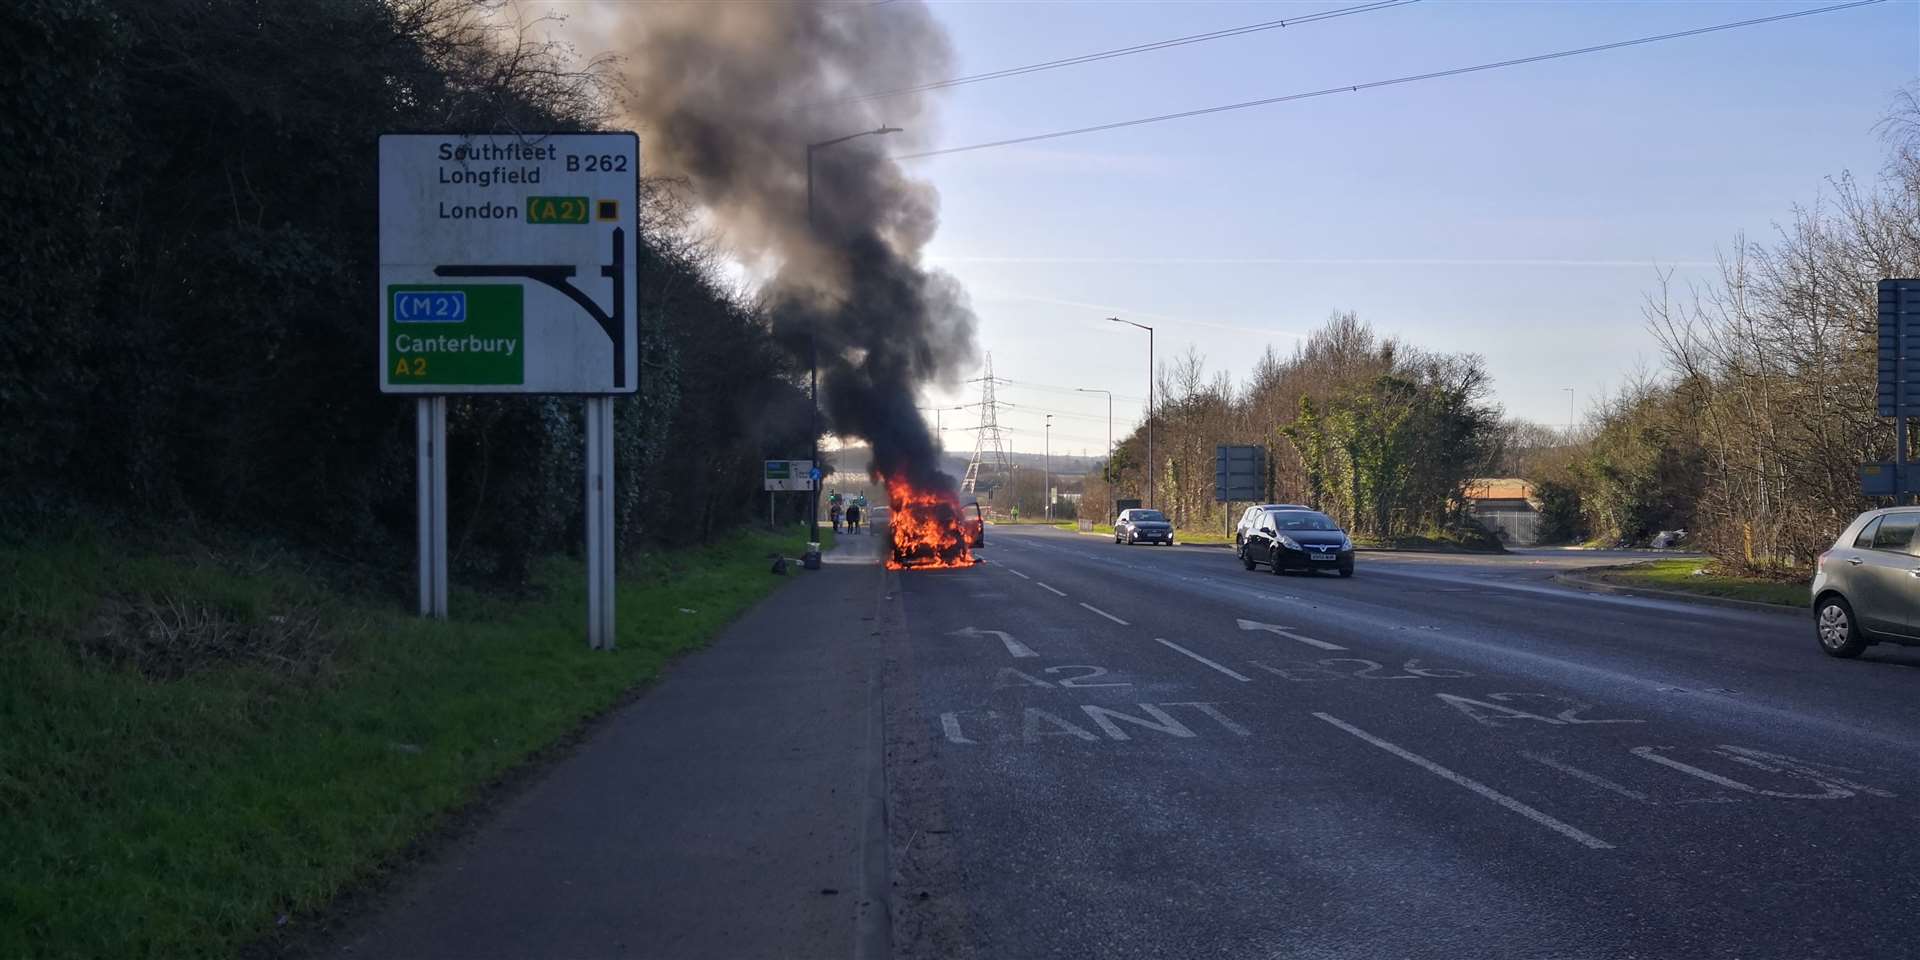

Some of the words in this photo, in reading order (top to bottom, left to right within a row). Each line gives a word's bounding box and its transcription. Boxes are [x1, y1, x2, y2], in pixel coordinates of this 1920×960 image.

[438, 143, 557, 161] Southfleet
[438, 166, 541, 187] Longfield
[438, 201, 518, 219] London
[529, 201, 586, 221] (A2)
[399, 295, 462, 318] (M2)
[395, 334, 517, 356] Canterbury
[395, 357, 427, 376] A2
